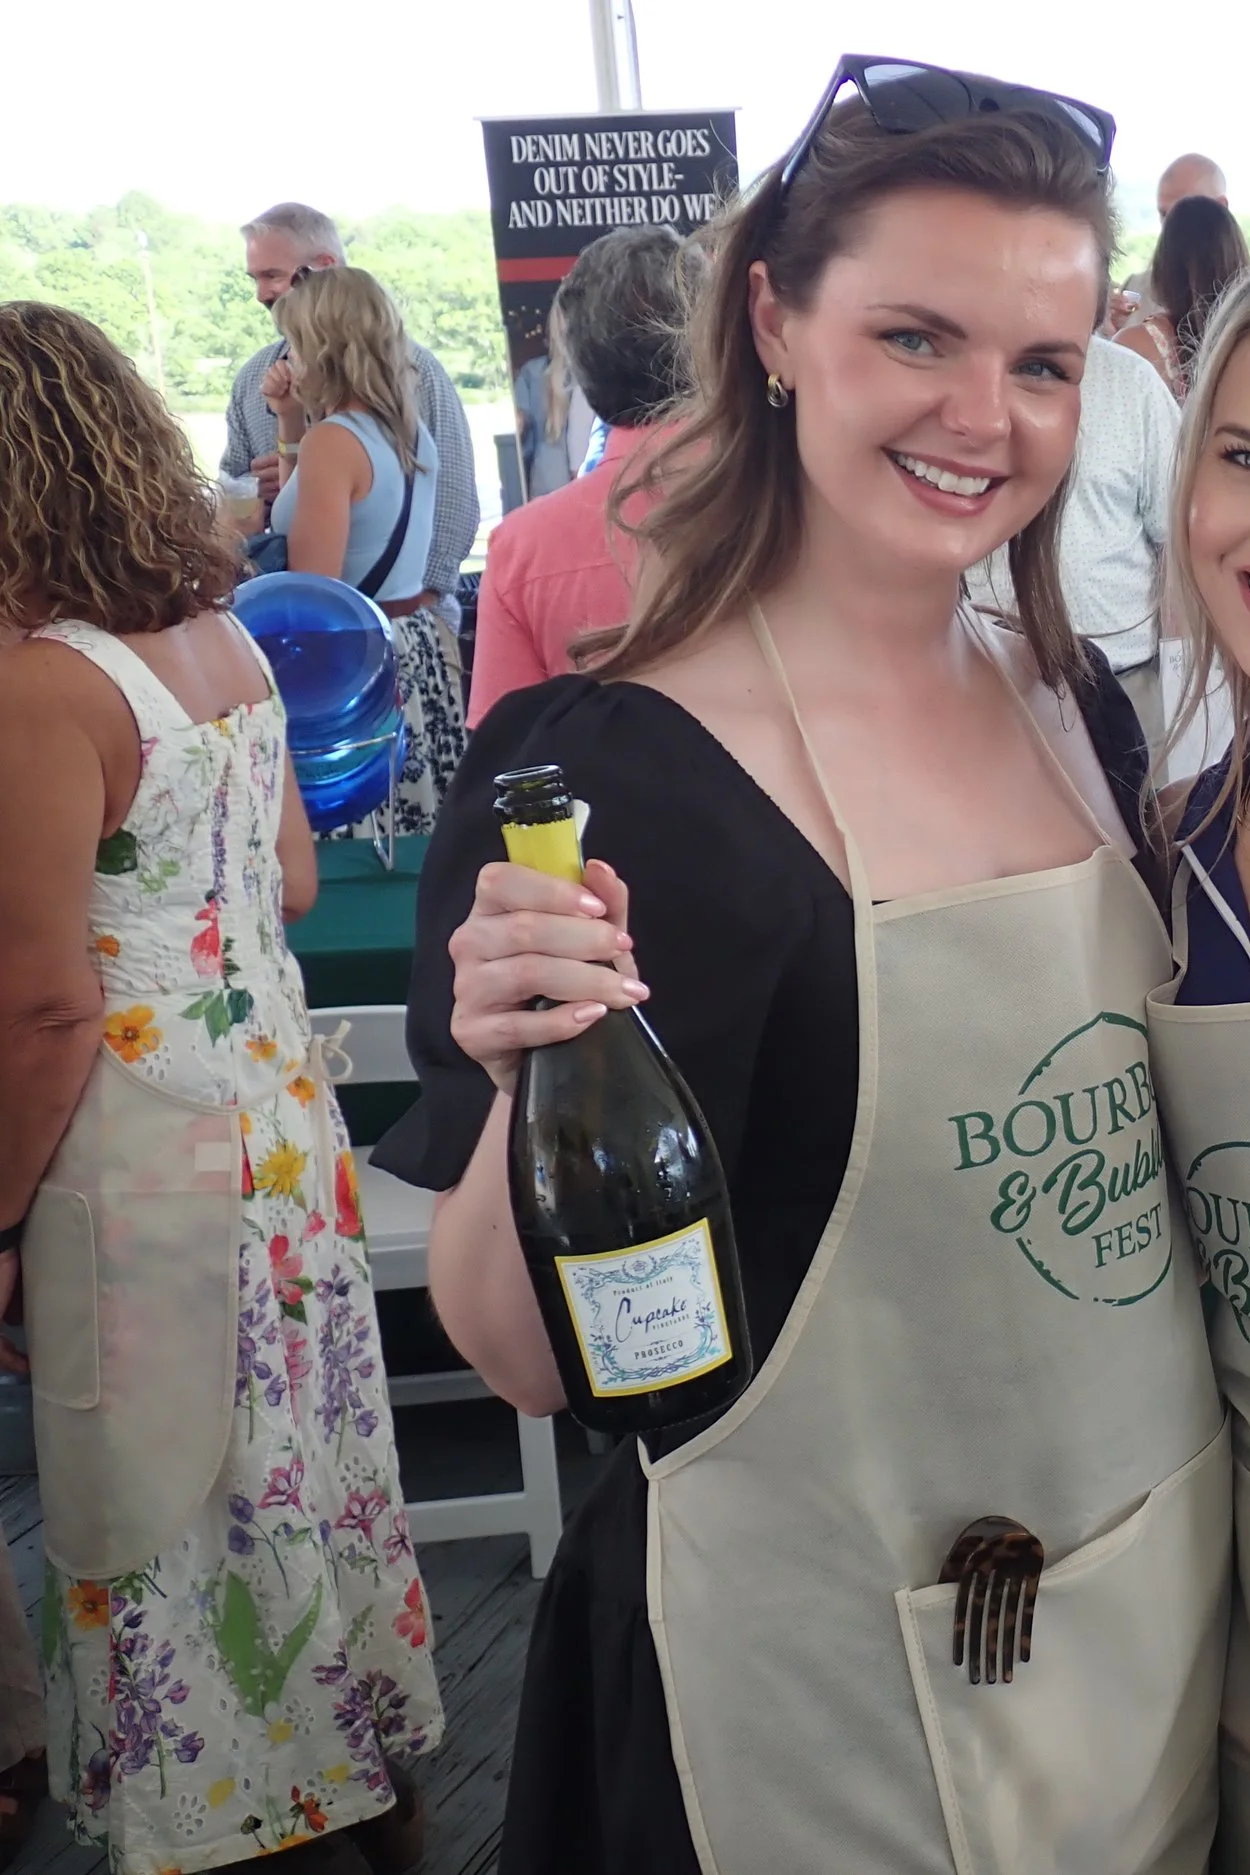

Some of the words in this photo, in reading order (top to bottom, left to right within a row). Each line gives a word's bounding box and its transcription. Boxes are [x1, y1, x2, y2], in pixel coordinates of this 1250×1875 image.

[511, 133, 580, 163] DENIM
[585, 131, 655, 161] NEVER
[656, 129, 711, 158] GOES
[534, 166, 578, 195] OUT
[582, 165, 609, 193] OF
[613, 162, 685, 193] STYLE-
[508, 200, 551, 228] AND
[557, 197, 651, 227] NEITHER
[652, 195, 680, 223] DO
[948, 1061, 1156, 1170] BOURB
[990, 1170, 1037, 1233] &
[1091, 1203, 1162, 1268] FEST
[615, 1296, 687, 1343] Cupcake
[634, 1340, 684, 1360] PROSECCO
